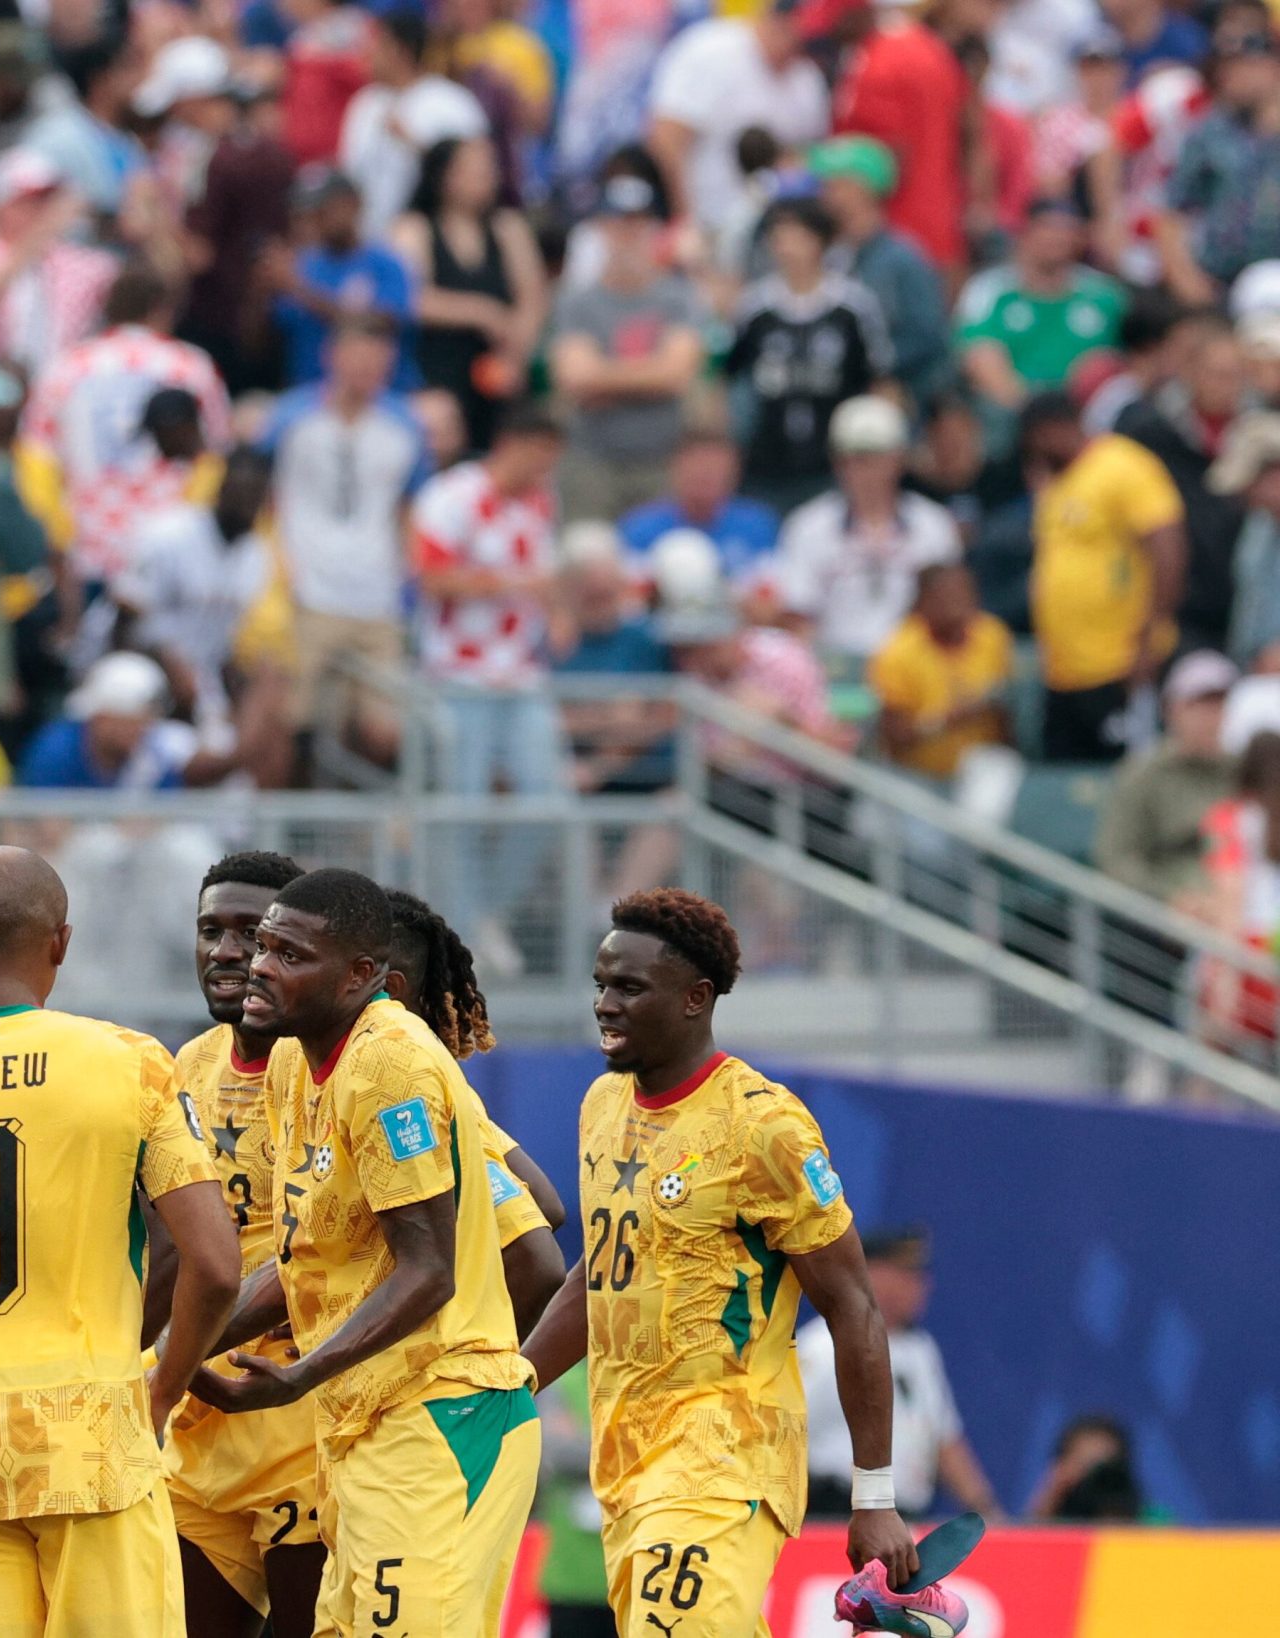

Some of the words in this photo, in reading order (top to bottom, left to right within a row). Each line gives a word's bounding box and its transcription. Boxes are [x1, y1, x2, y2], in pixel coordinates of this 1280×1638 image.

[588, 1208, 639, 1292] 26
[271, 1501, 320, 1544] 2
[372, 1558, 404, 1627] 5
[641, 1543, 709, 1610] 26
